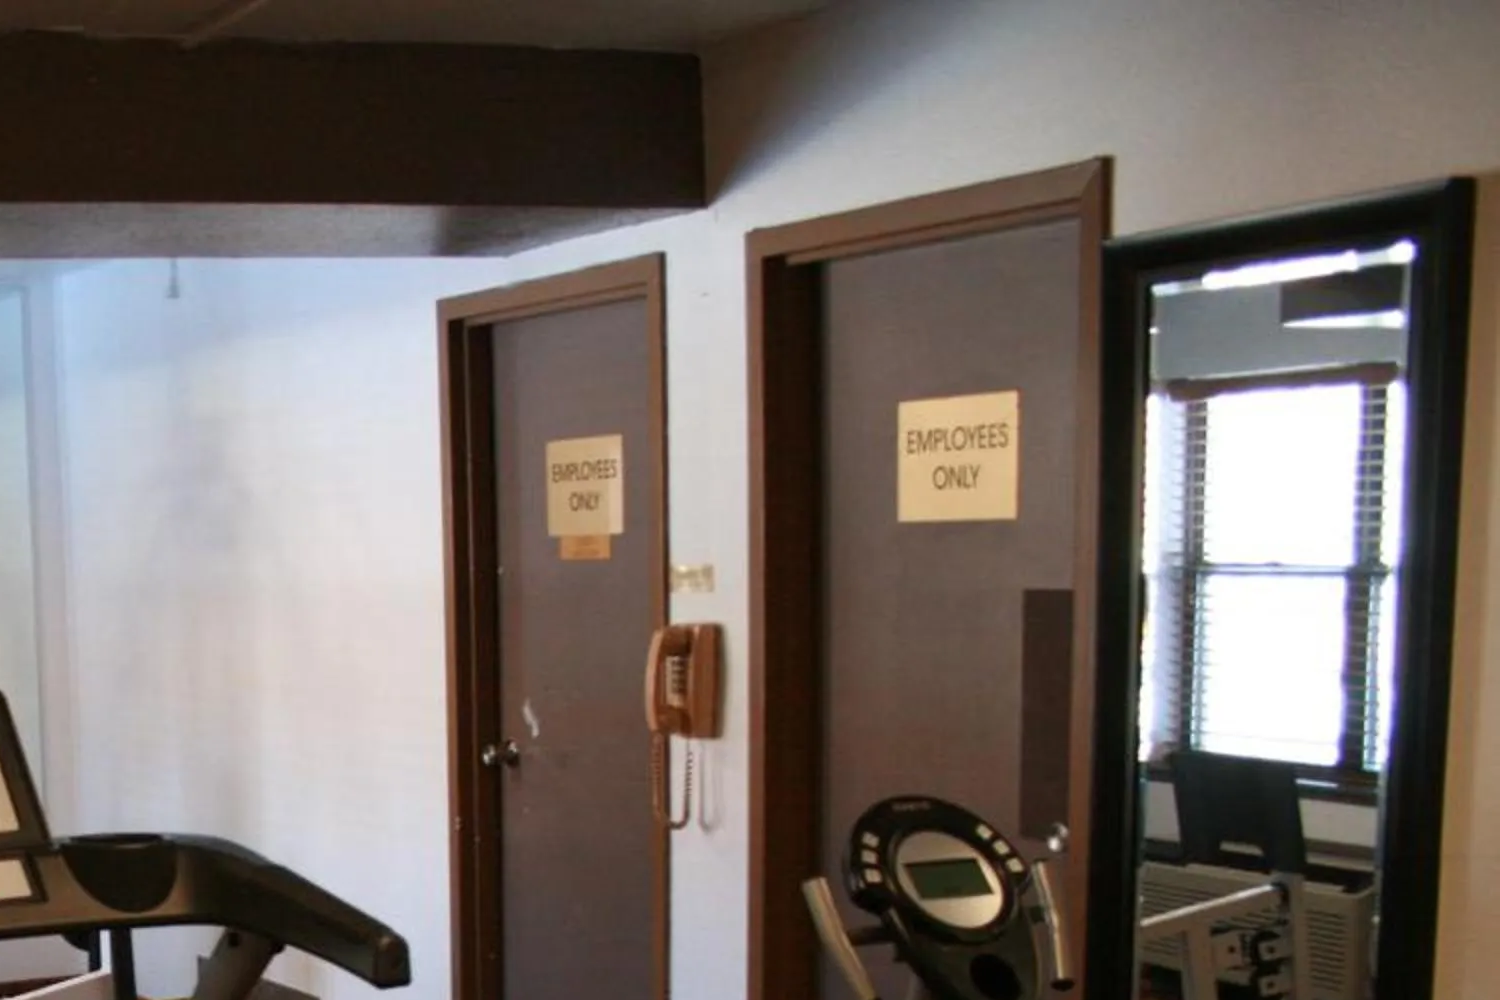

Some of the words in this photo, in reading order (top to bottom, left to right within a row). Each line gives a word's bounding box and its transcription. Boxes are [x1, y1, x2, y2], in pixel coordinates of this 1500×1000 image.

[907, 421, 1010, 455] EMPLOYEES
[551, 458, 618, 483] EMPLOYEES
[932, 463, 981, 491] ONLY
[568, 490, 602, 512] ONLY
